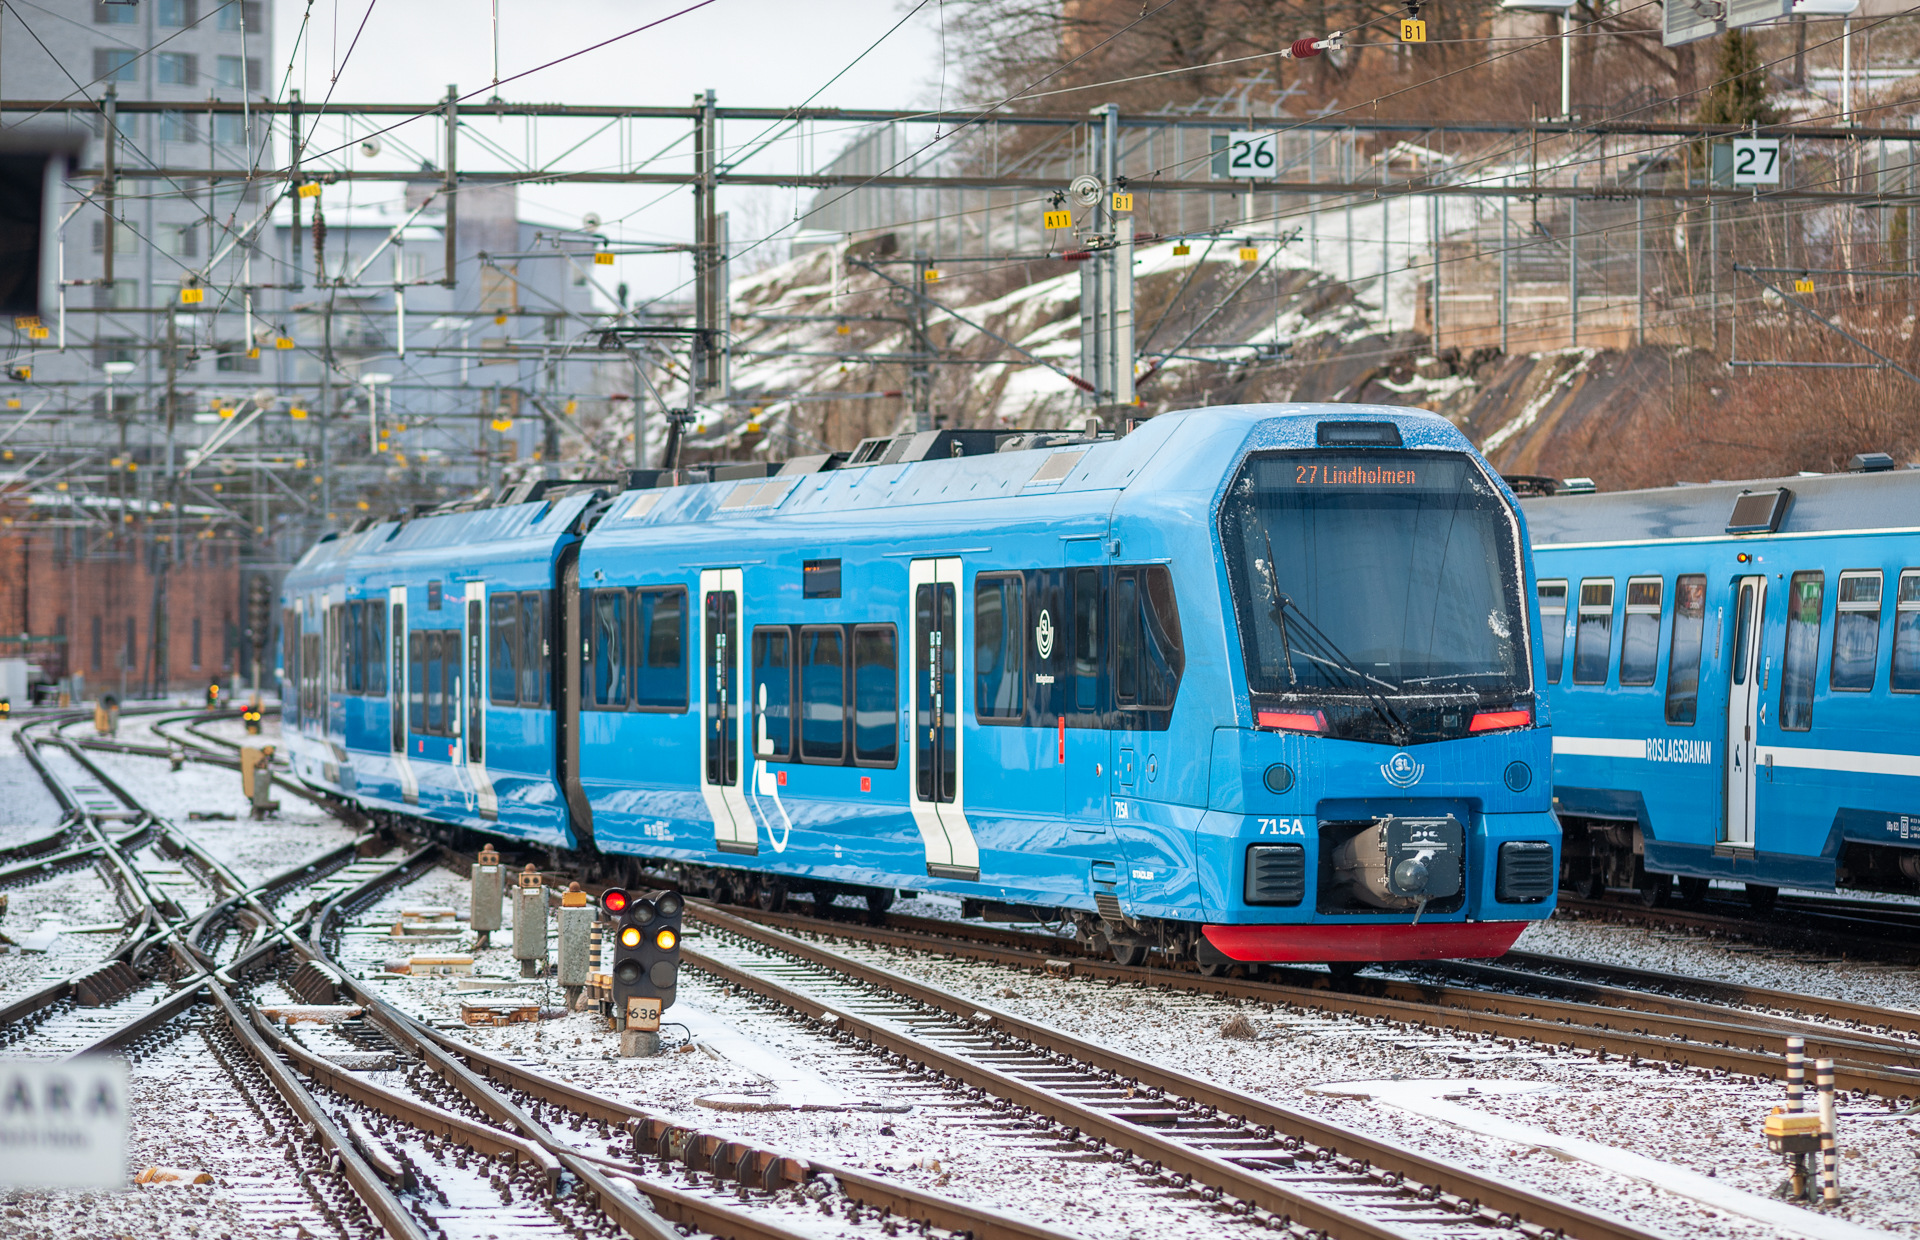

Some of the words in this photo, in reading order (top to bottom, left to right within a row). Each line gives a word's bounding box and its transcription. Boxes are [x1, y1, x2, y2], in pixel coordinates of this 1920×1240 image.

[1405, 25, 1420, 40] B1
[1231, 140, 1274, 168] 26
[1736, 147, 1778, 175] 27
[1116, 197, 1129, 209] B1
[1048, 214, 1068, 227] A11
[1296, 465, 1318, 484] 27
[1323, 465, 1416, 484] Lindholmen
[1041, 619, 1048, 635] SL
[1646, 737, 1712, 765] ROSLAGSBANAN
[1395, 758, 1411, 771] SL
[1114, 801, 1129, 819] 715A
[1257, 818, 1305, 836] 715A
[1132, 869, 1155, 881] STADLER
[630, 1007, 658, 1021] 638
